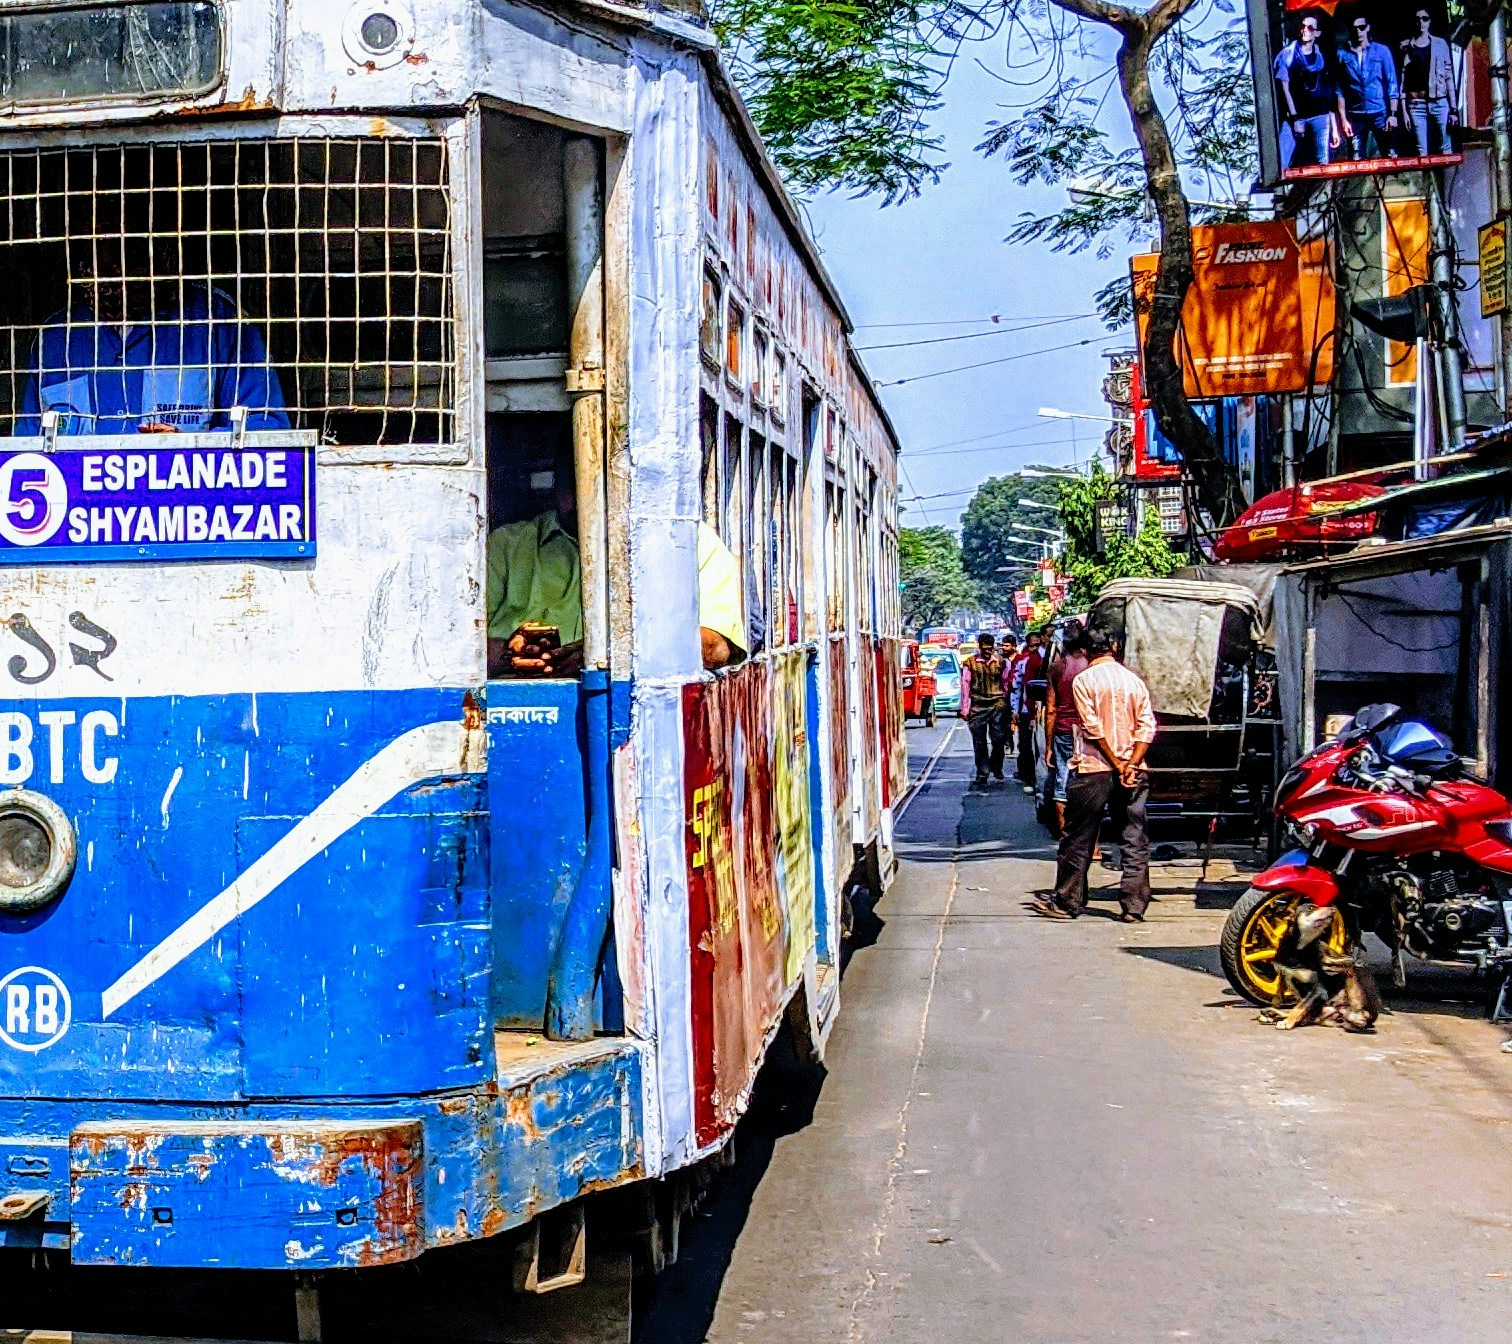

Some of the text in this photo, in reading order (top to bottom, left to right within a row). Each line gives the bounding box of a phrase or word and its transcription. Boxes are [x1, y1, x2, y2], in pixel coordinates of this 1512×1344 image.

[1214, 242, 1287, 265] FASHION
[183, 415, 200, 425] LIFE
[82, 452, 287, 491] ESPLANADE
[6, 468, 52, 535] 5
[67, 504, 303, 543] SHYAMBAZAR
[6, 984, 59, 1035] RB
